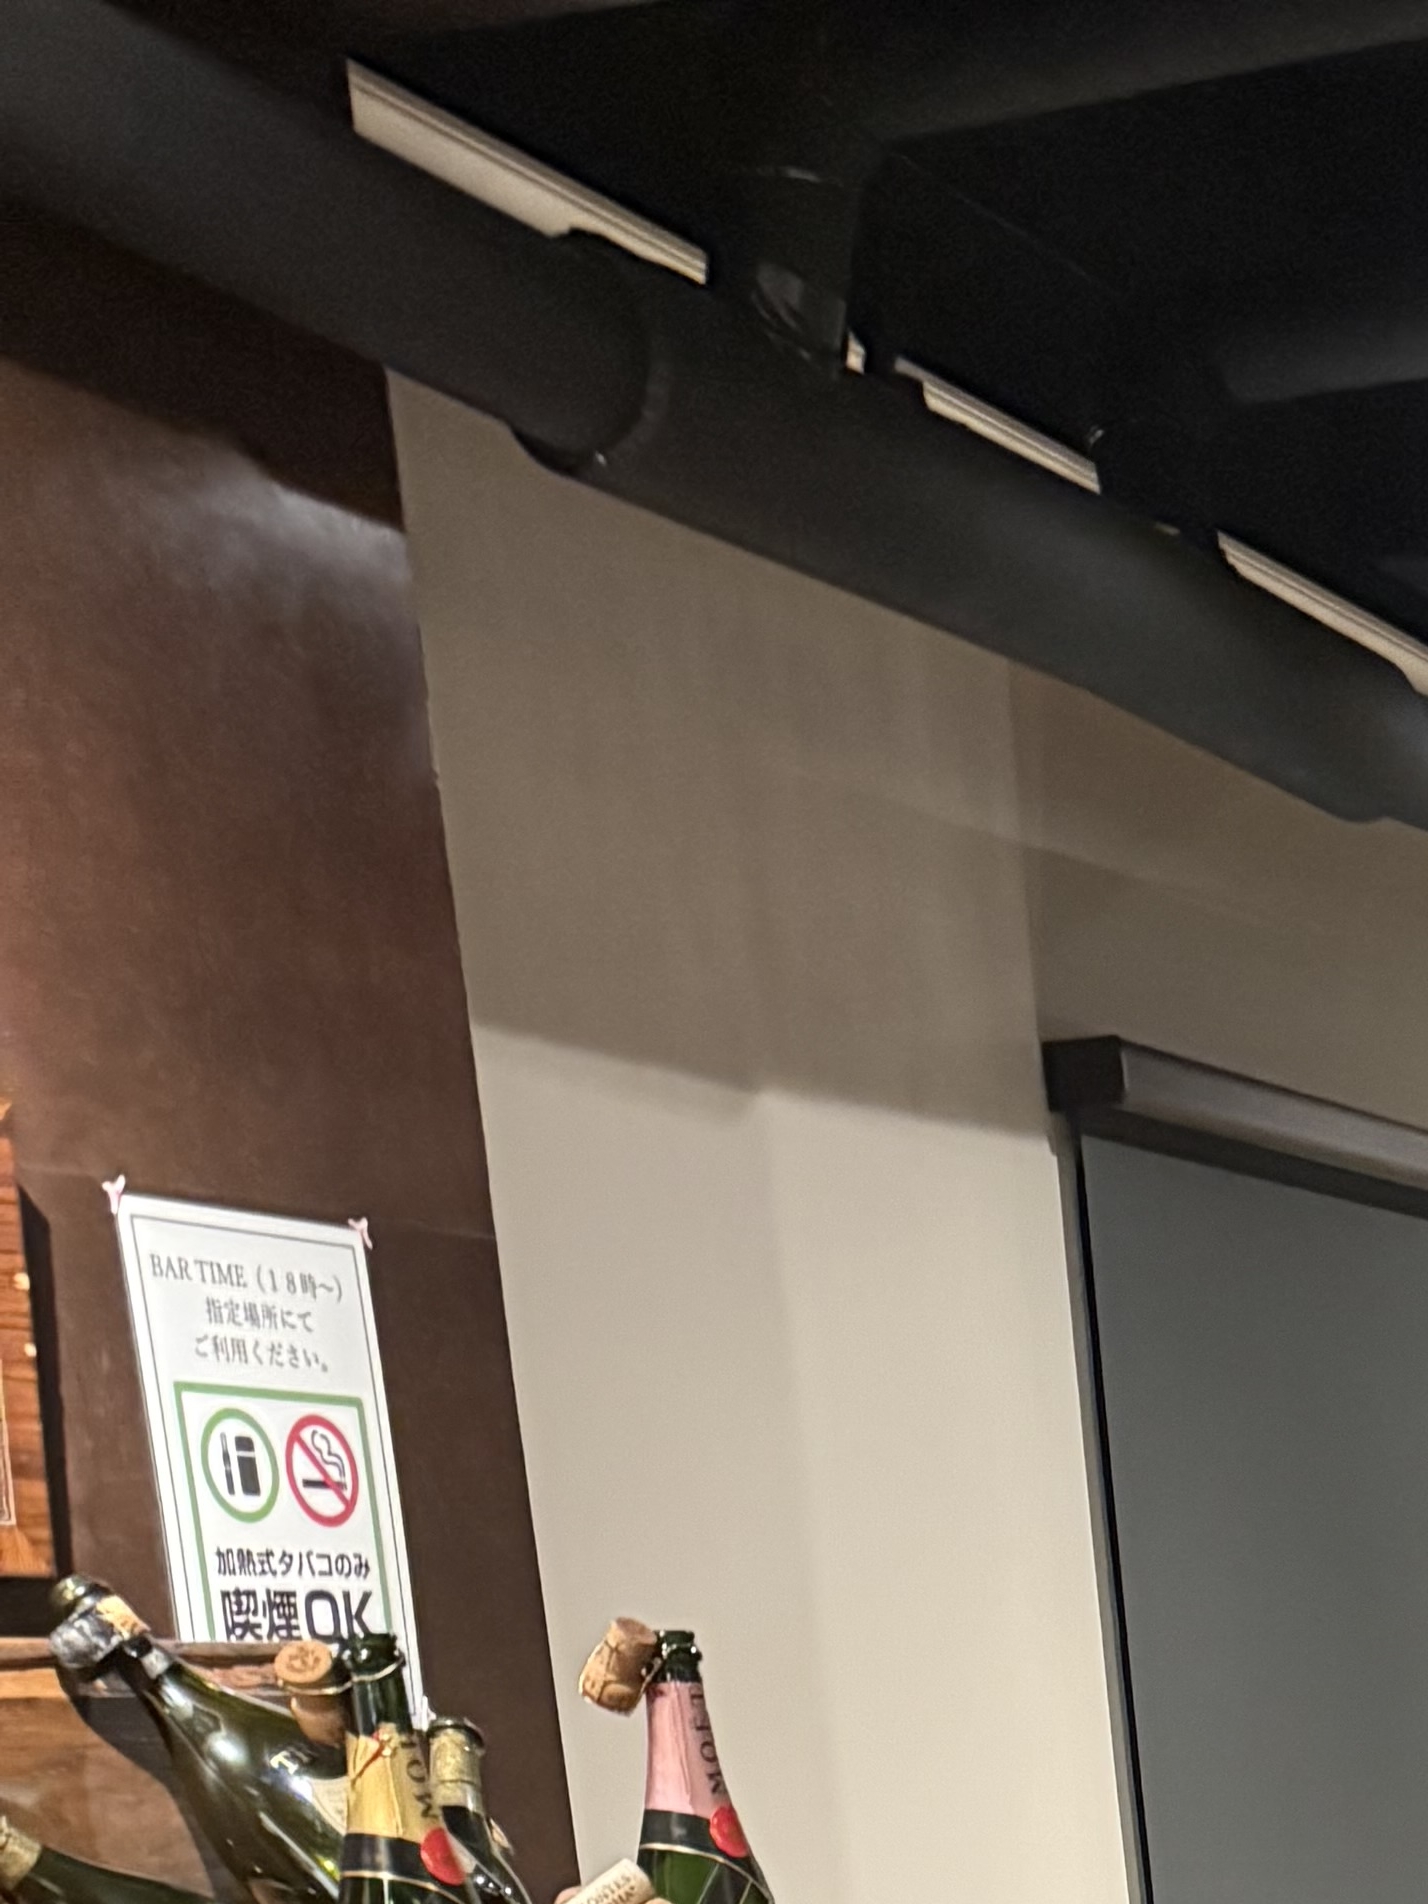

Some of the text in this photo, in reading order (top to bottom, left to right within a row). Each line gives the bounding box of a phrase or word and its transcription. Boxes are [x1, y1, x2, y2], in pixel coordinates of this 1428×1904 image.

[150, 1254, 192, 1281] BAR
[194, 1259, 248, 1290] TIME
[205, 1296, 315, 1333] 指定場所にて
[194, 1334, 329, 1373] ご利用ください。
[215, 1546, 371, 1580] 加熱式タバコのみ
[219, 1587, 373, 1644] 喫煙OK
